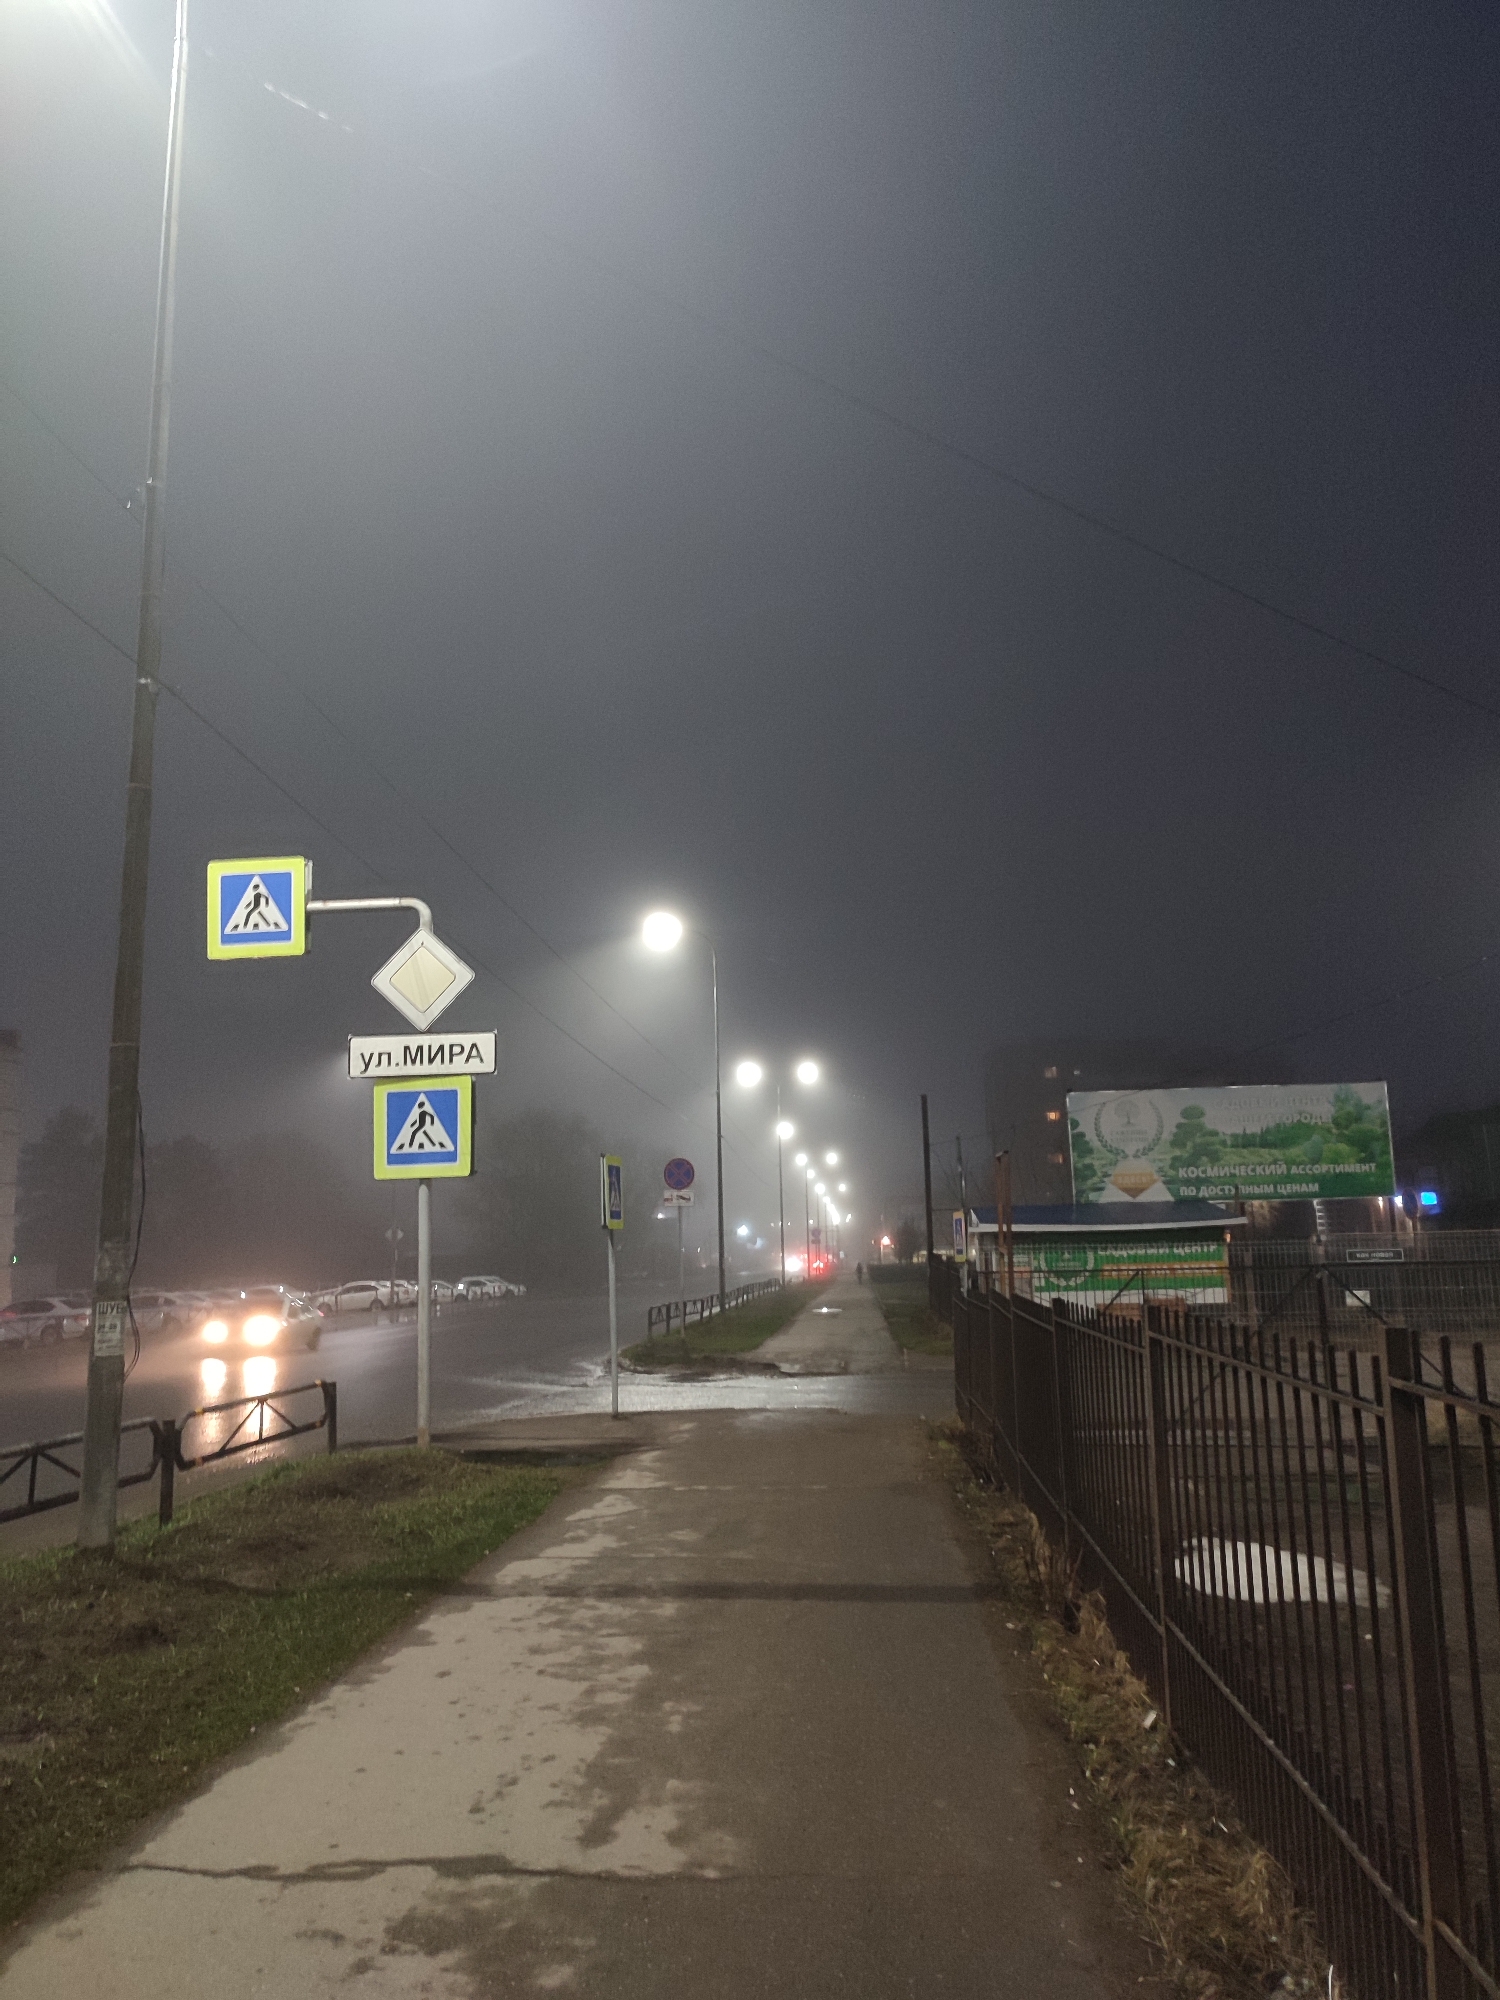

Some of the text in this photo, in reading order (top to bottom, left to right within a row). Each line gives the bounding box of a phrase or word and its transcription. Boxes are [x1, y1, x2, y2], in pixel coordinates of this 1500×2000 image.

[359, 1042, 485, 1075] ул.МИРА
[1178, 1161, 1376, 1178] КОСМИЧЕСКИЙ АССОРТИМЕНТ
[1179, 1186, 1197, 1196] ПО
[1277, 1183, 1320, 1196] ЦЕНАМ
[1098, 1242, 1218, 1257] САДОВЫЙ ЦЕНТР
